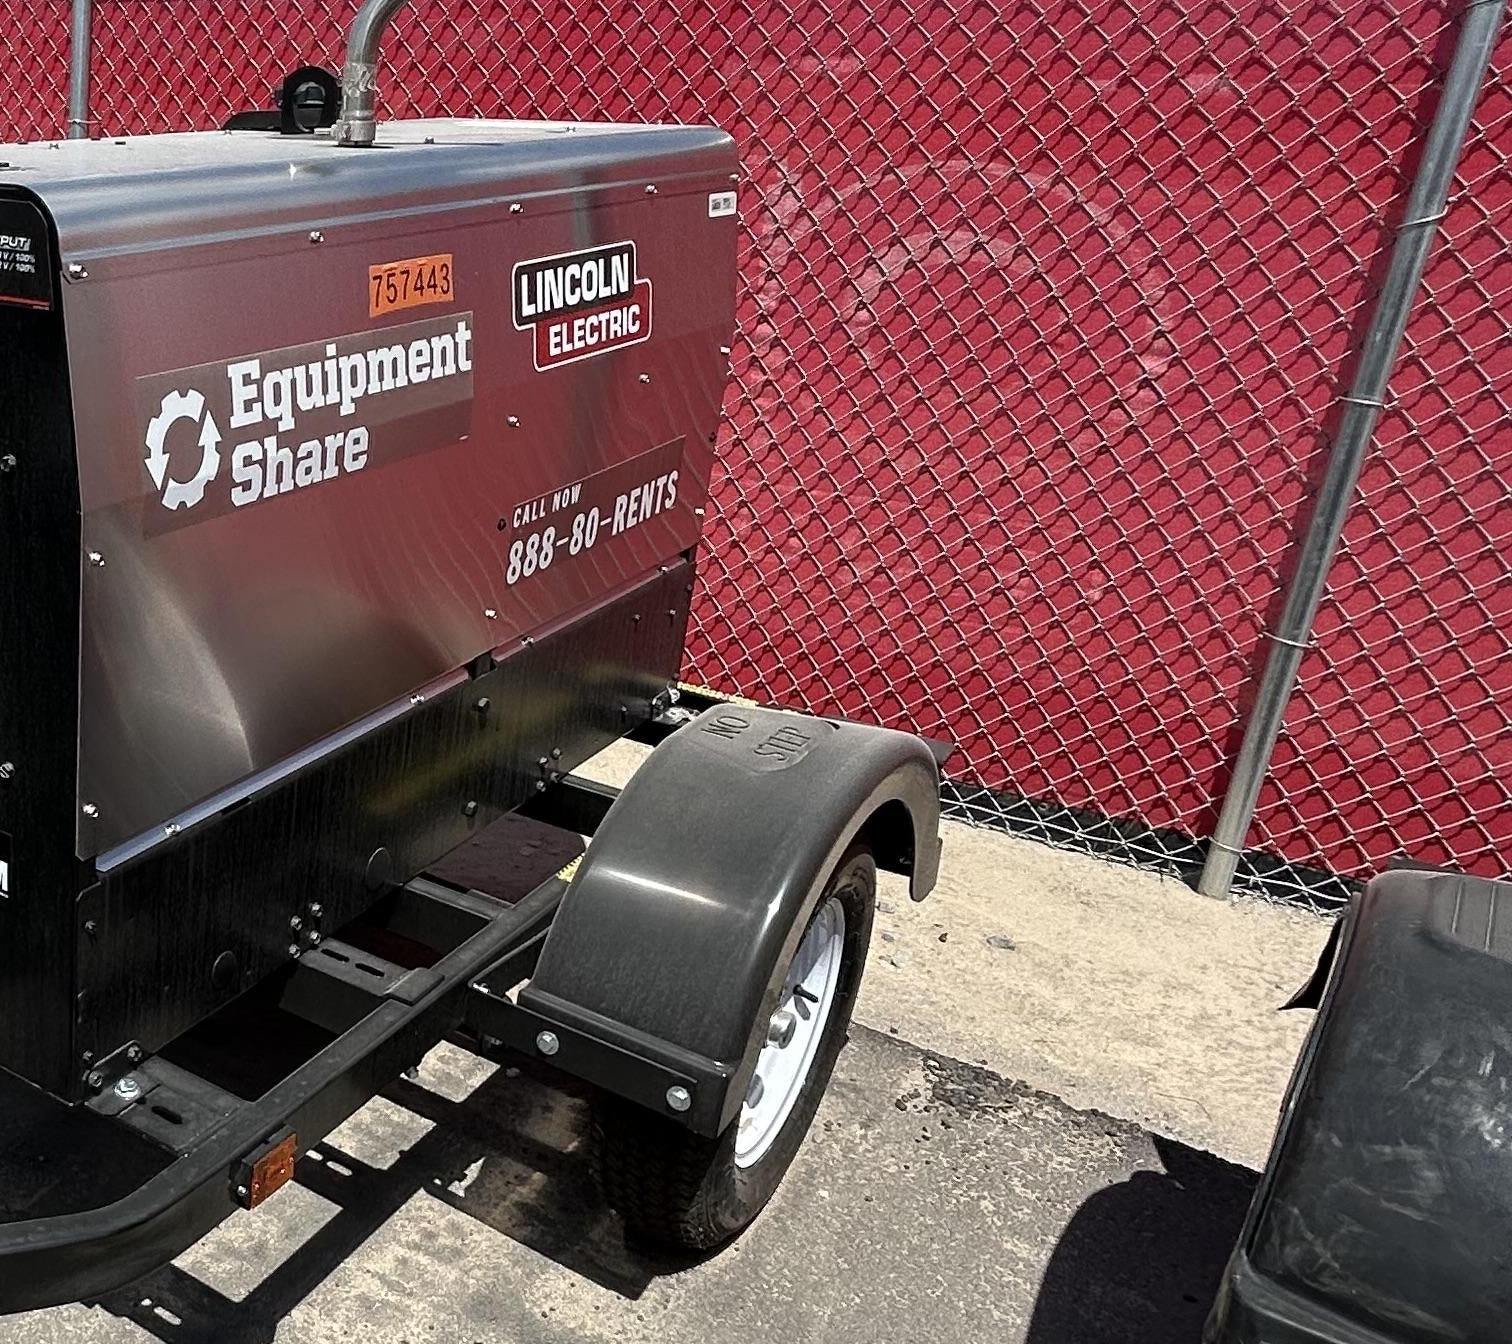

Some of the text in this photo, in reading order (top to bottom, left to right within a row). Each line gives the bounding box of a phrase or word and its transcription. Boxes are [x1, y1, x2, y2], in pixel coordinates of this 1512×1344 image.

[371, 262, 451, 309] 757443
[521, 253, 629, 317] LINCOLN
[548, 303, 641, 357] ELECTRIC
[227, 320, 473, 433] Equipment
[230, 425, 370, 507] Share
[505, 469, 680, 585] 888-80-RENTS
[512, 482, 583, 529] CALL NOW
[700, 716, 750, 739] NO
[753, 726, 811, 761] STEP
